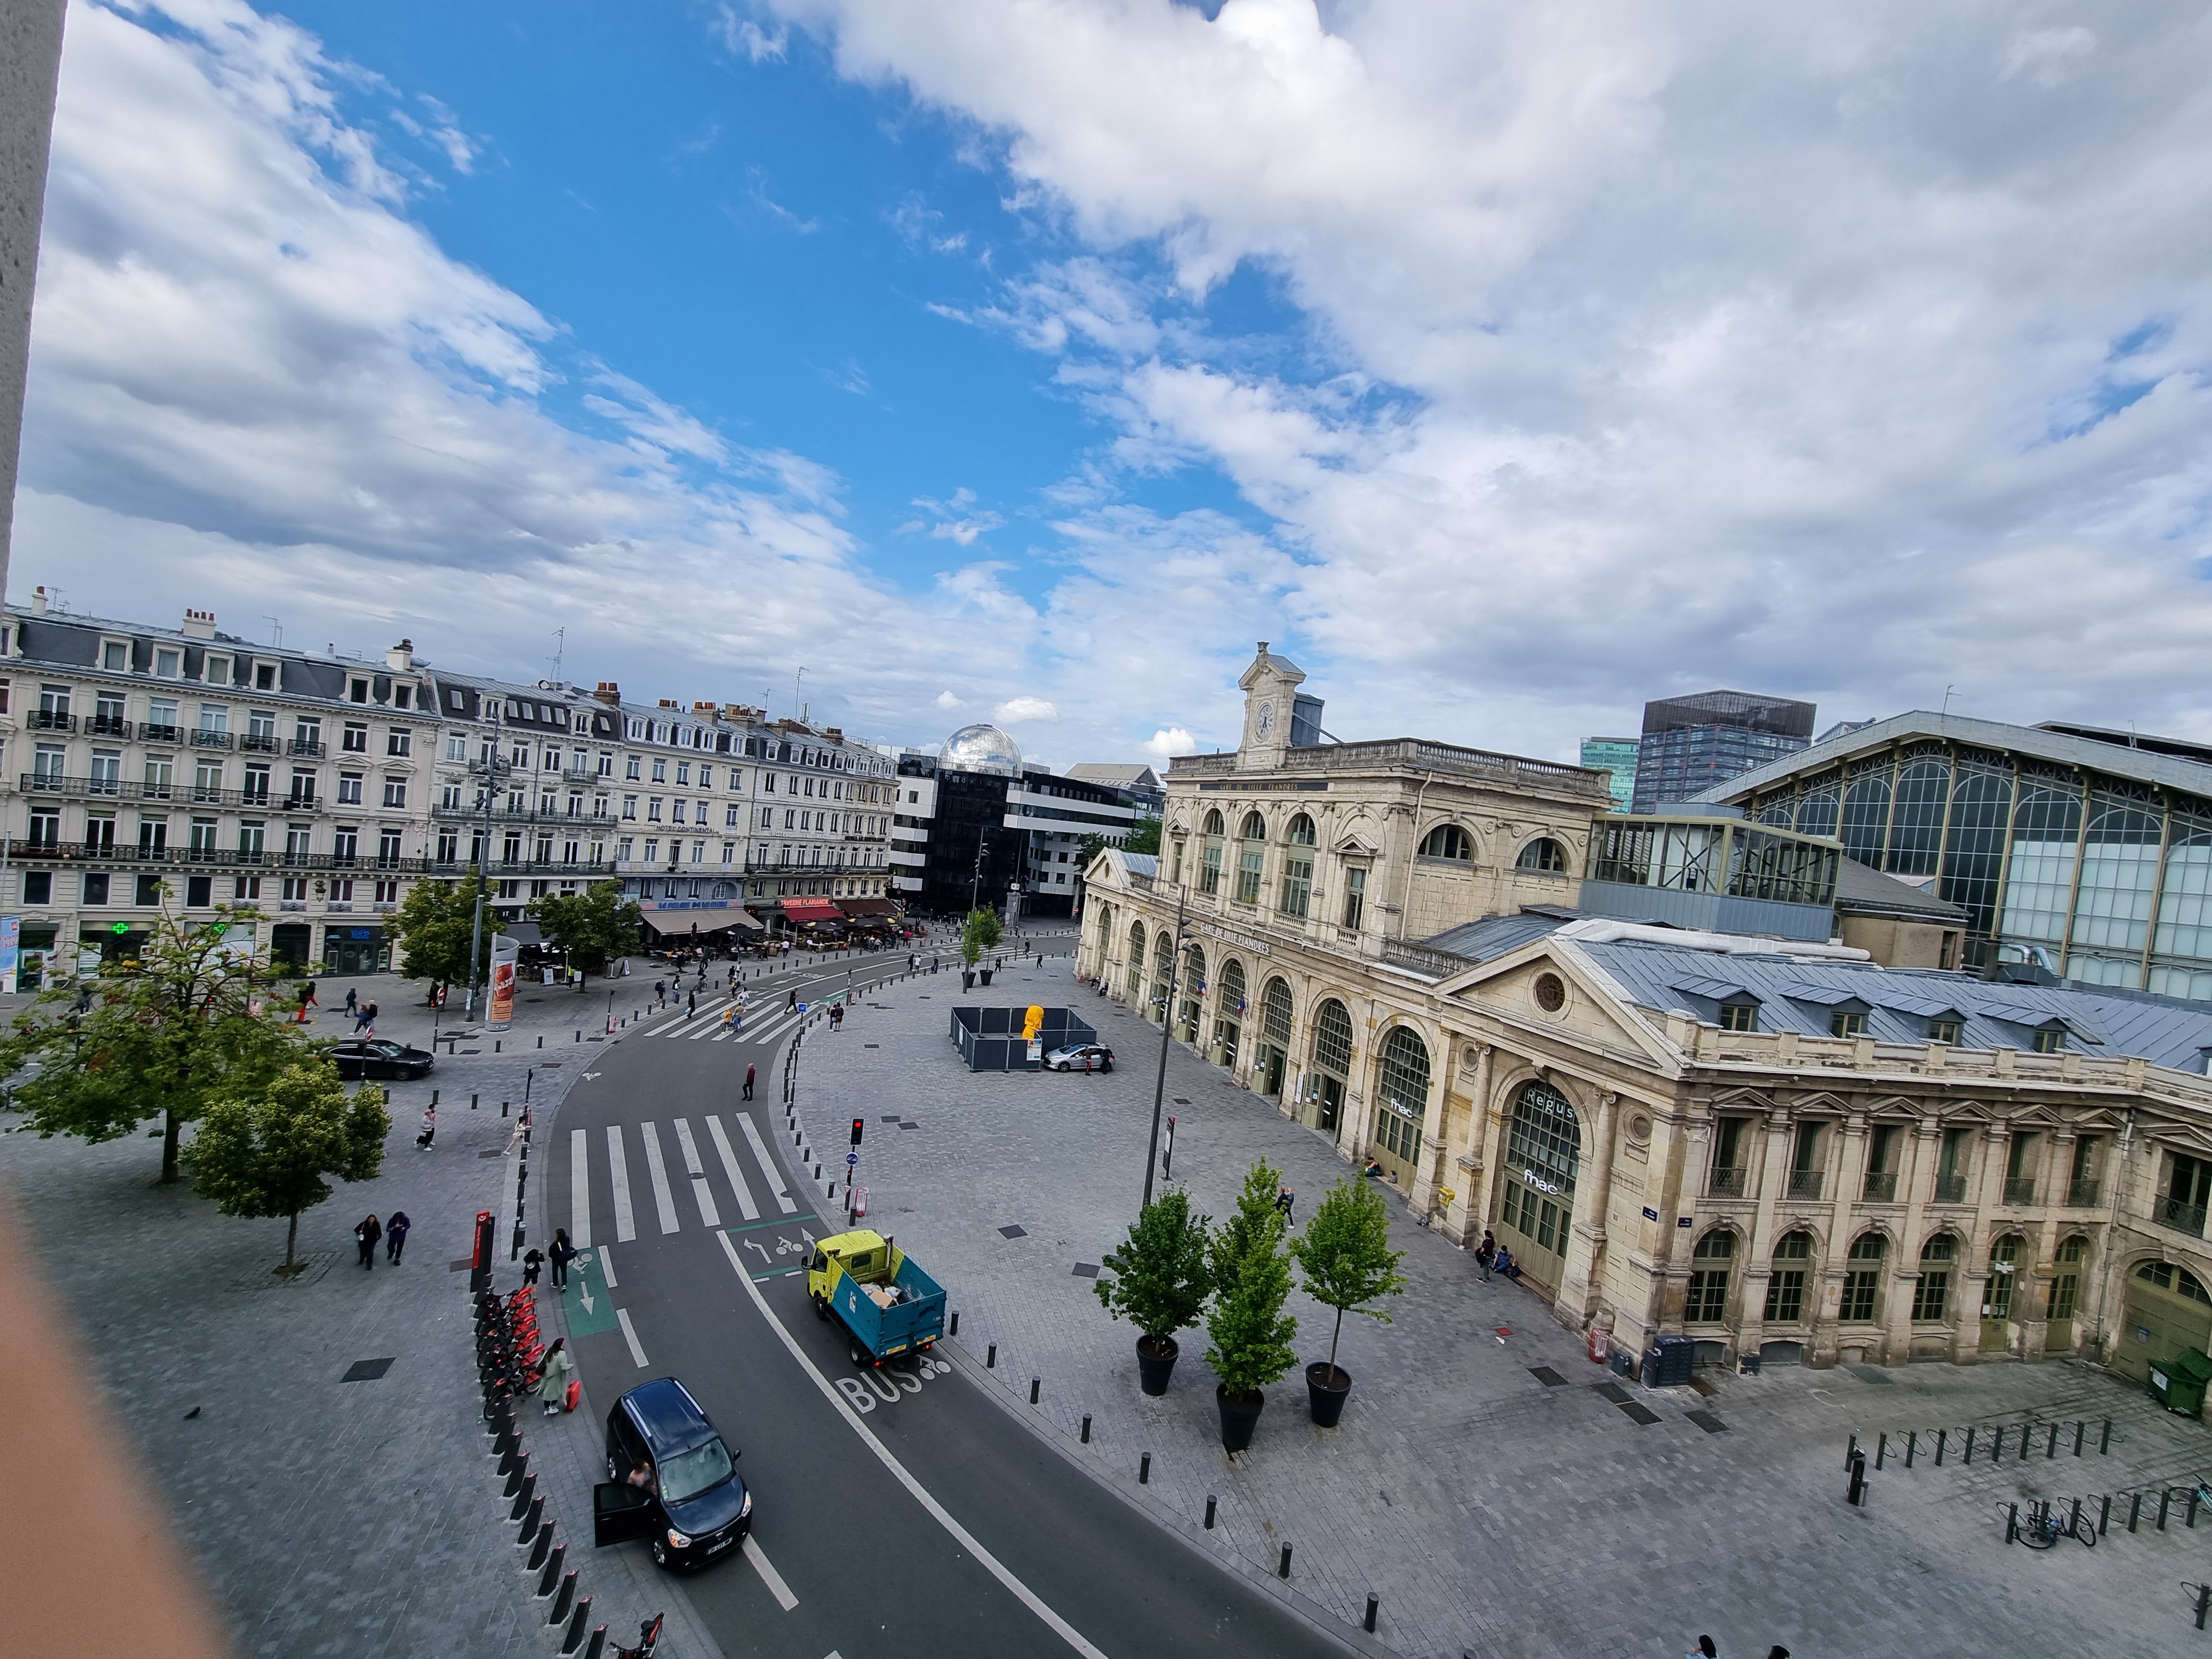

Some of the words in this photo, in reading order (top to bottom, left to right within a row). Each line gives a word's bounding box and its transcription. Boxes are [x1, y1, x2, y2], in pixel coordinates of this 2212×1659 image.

[1200, 922, 1215, 934] GARE
[1215, 927, 1223, 938] DE
[1224, 930, 1238, 943] LILLE
[1238, 935, 1269, 953] FLANDRES
[1391, 1098, 1413, 1118] fnac
[1527, 1089, 1574, 1118] Regus
[1524, 1169, 1558, 1195] fnac
[835, 1362, 922, 1414] BUS
